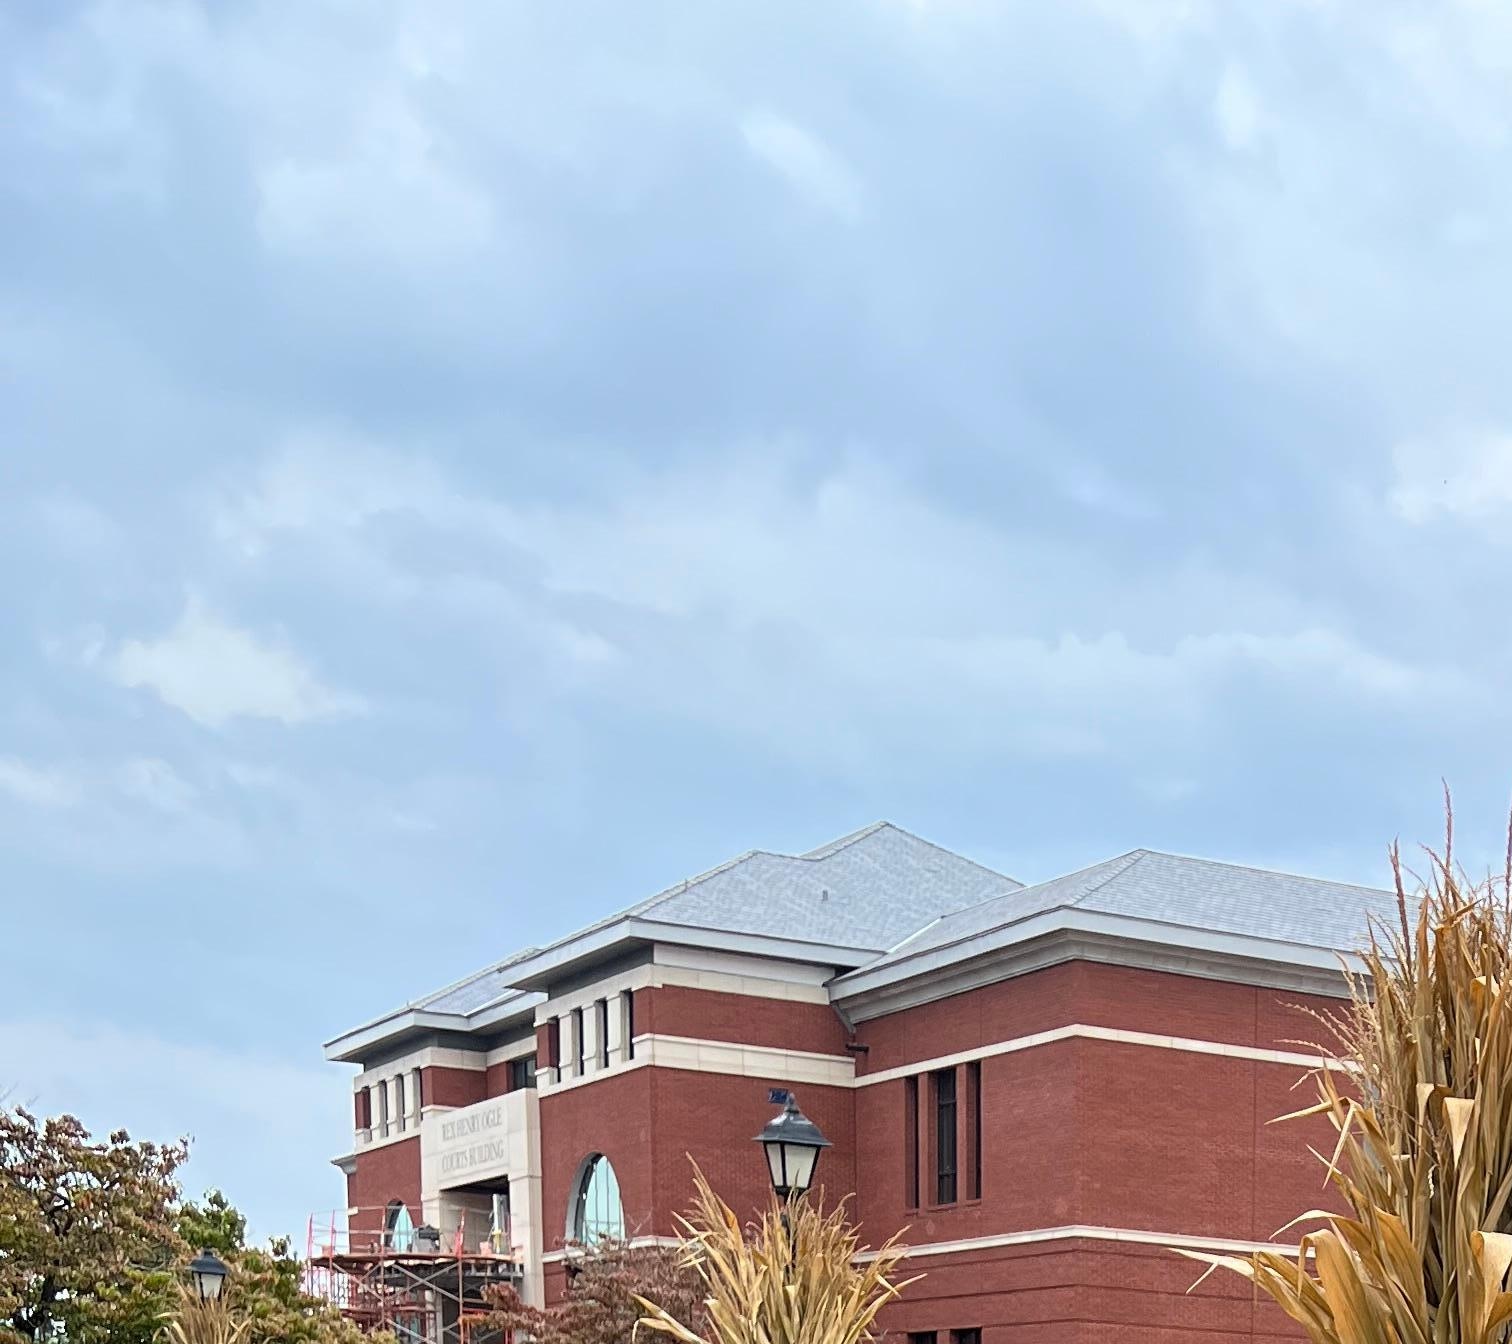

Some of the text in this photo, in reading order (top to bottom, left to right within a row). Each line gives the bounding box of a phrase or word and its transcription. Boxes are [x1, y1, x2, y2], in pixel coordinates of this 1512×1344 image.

[456, 1113, 480, 1136] HENRY
[481, 1107, 502, 1128] OGLE
[442, 1139, 504, 1172] COURTS BUILDING
